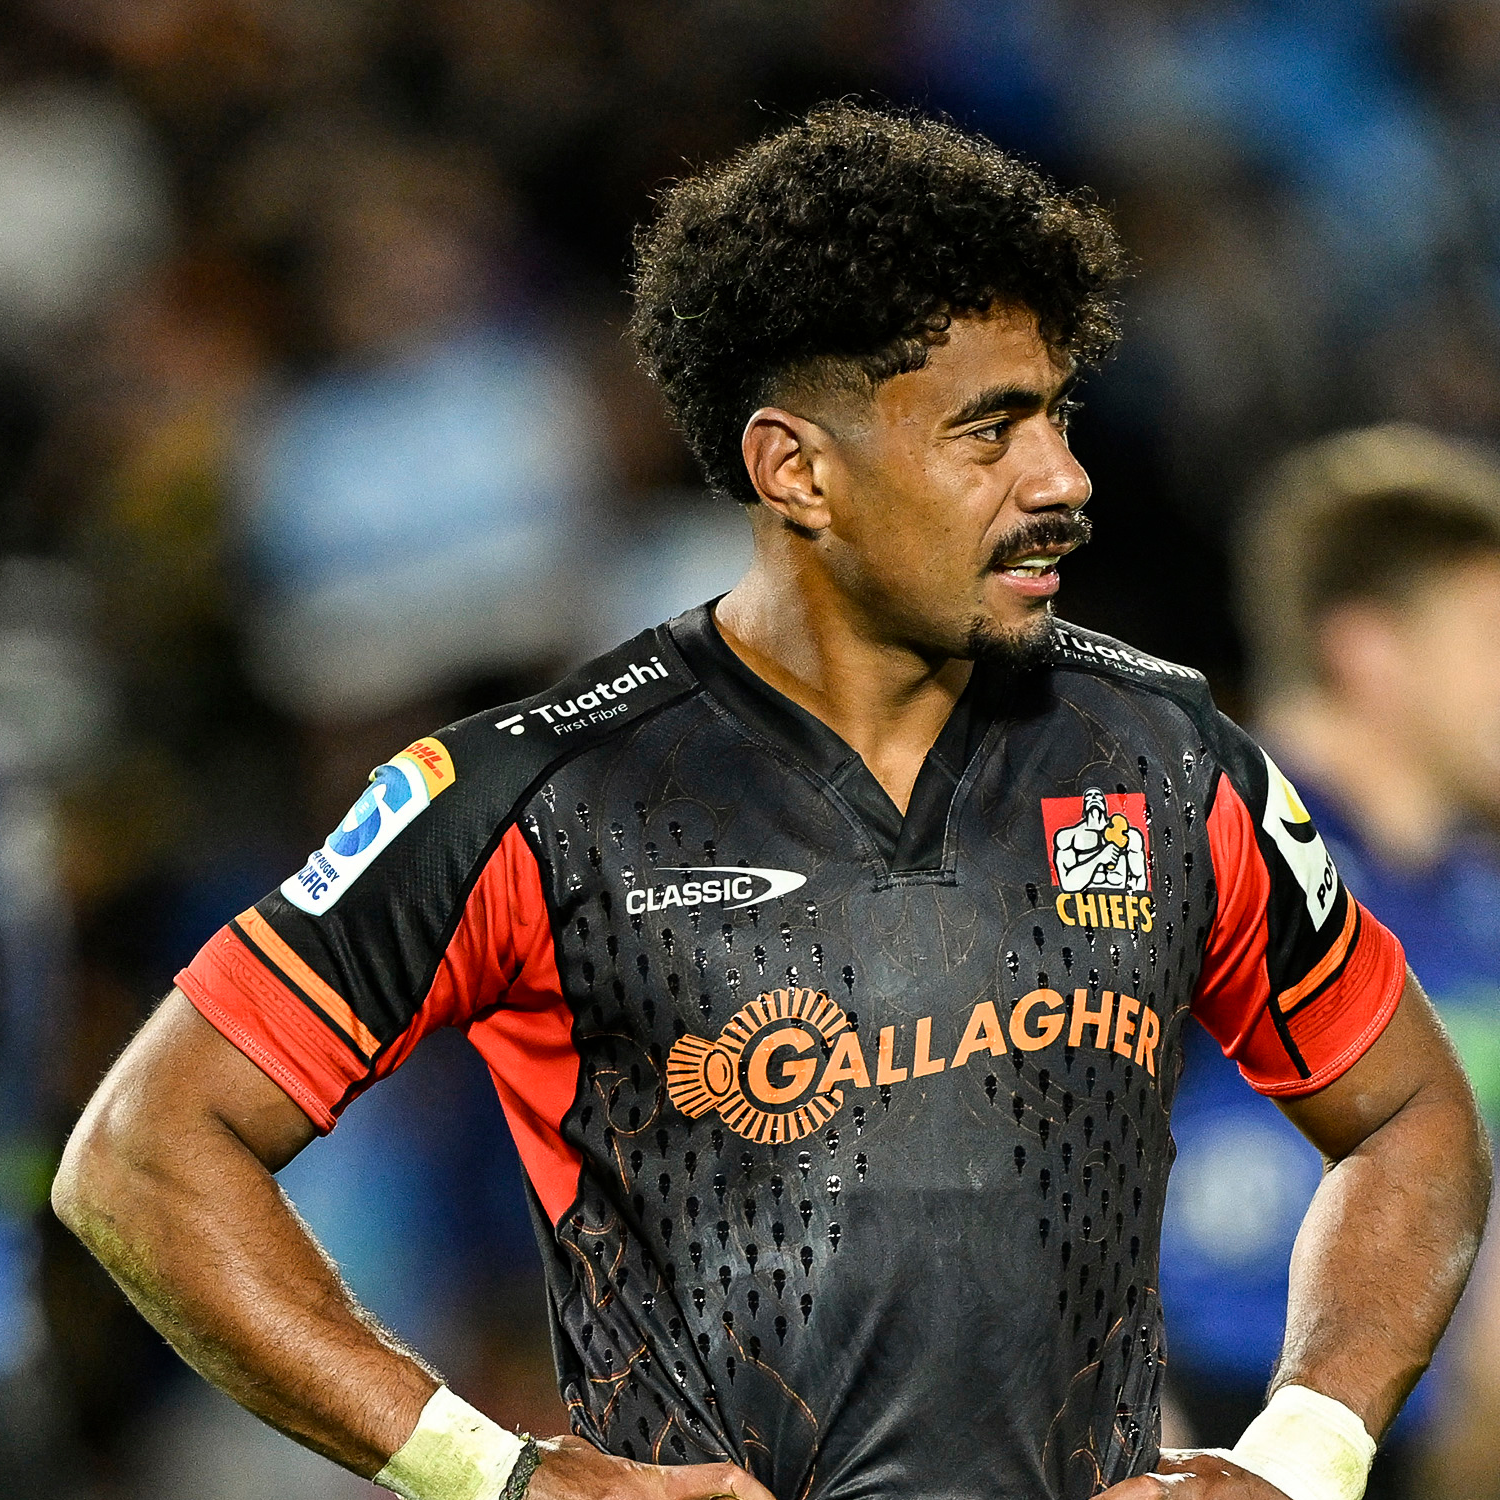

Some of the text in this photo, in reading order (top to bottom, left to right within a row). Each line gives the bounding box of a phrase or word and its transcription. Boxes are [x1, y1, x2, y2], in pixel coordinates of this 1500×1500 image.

[1055, 627, 1198, 679] Tuatahi
[1063, 648, 1146, 677] First Fibre
[529, 656, 669, 724] Tuatahi
[553, 702, 629, 736] First Fibre
[405, 742, 443, 770] DHL
[625, 876, 753, 915] CLASSIC
[1055, 892, 1154, 933] CHIEFS
[746, 987, 1161, 1104] GALLAGHER
